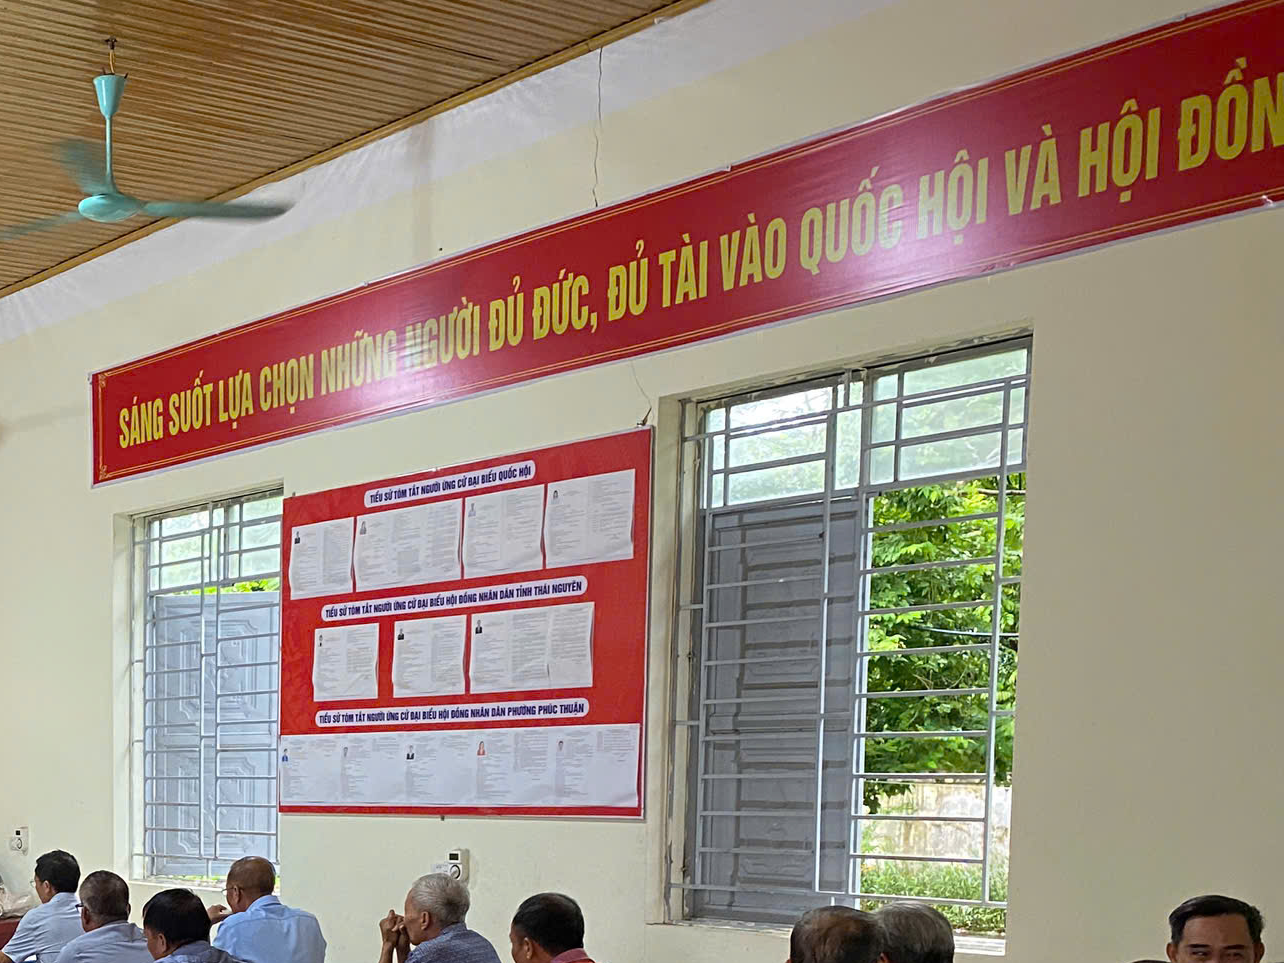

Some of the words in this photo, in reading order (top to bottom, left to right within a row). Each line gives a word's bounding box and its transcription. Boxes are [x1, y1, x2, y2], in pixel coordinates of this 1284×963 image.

[119, 396, 164, 448] SÁNG
[168, 370, 214, 436] SUỐT
[218, 370, 254, 430] LỰA
[259, 353, 314, 414] CHỌN
[320, 329, 397, 396] NHỮNG
[404, 296, 481, 372] NGƯỜI
[488, 276, 524, 352] ĐỦ
[532, 268, 598, 340] ĐỨC,
[607, 240, 648, 322] ĐỦ
[659, 233, 708, 308] TÀI
[720, 212, 787, 292] VÀO
[800, 166, 904, 276] QUỐC
[916, 149, 989, 245] HỘI
[1004, 123, 1062, 216] VÀ
[1078, 98, 1161, 204] HỘI
